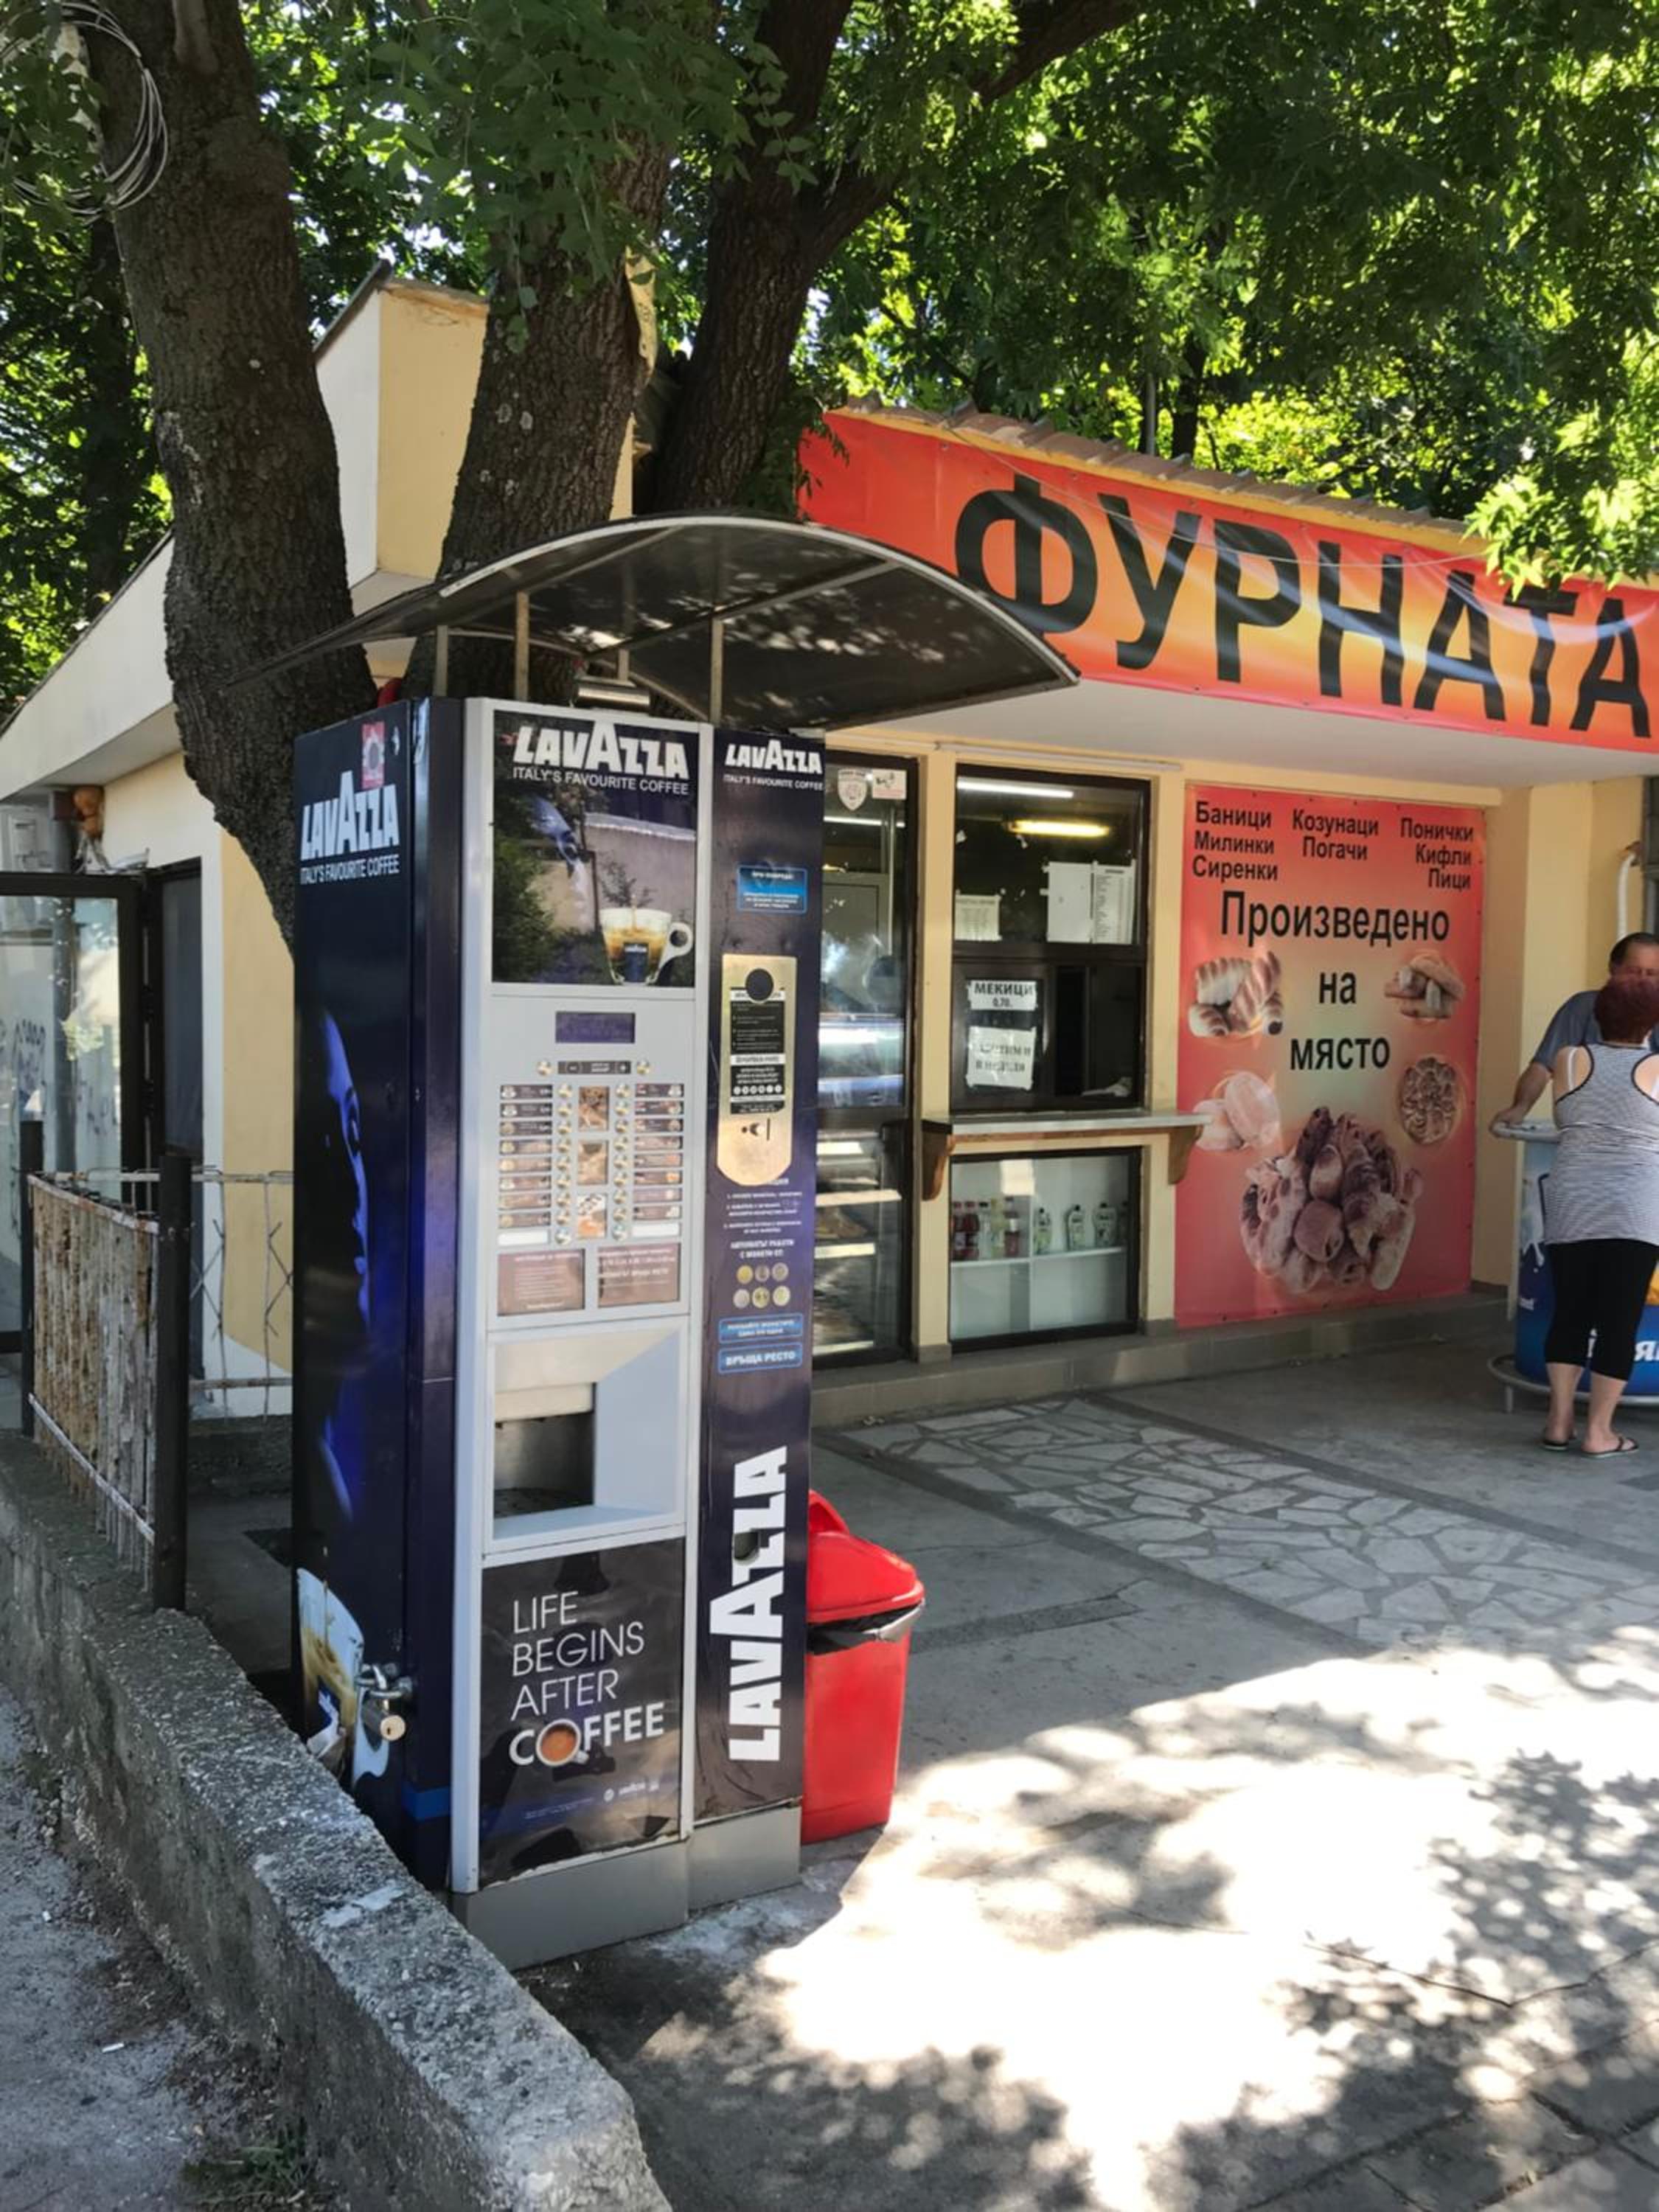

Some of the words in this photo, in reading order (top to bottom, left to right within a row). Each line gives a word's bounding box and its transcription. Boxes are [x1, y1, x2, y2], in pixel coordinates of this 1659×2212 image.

[954, 473, 1652, 739] ФУРНАТА
[512, 720, 689, 780] LAVAZZA
[725, 739, 823, 774] LAVAZZA
[512, 767, 561, 784] ITALY'S
[565, 771, 636, 791] FAVOURITE
[639, 779, 689, 796] COFFEE
[794, 780, 824, 791] COFFEE
[300, 769, 400, 861] LAVAZZA
[1195, 801, 1273, 830] Баници
[1292, 809, 1379, 838] Козунаци
[1400, 818, 1474, 841] Понички
[1194, 830, 1275, 855] Милинки
[1302, 836, 1368, 860] Погачи
[1415, 844, 1472, 869] Кифли
[368, 855, 400, 876] COFFEE
[1192, 855, 1279, 883] Сиренки
[1427, 868, 1472, 890] Пици
[1221, 889, 1450, 947] Произведено
[974, 982, 1034, 997] МЕКИЦИ
[1318, 971, 1357, 1004] на
[513, 1590, 579, 1634] LIFE
[709, 1446, 787, 1761] LAVAZZA
[512, 1621, 645, 1677] BEGINS
[510, 1669, 619, 1722] AFTER
